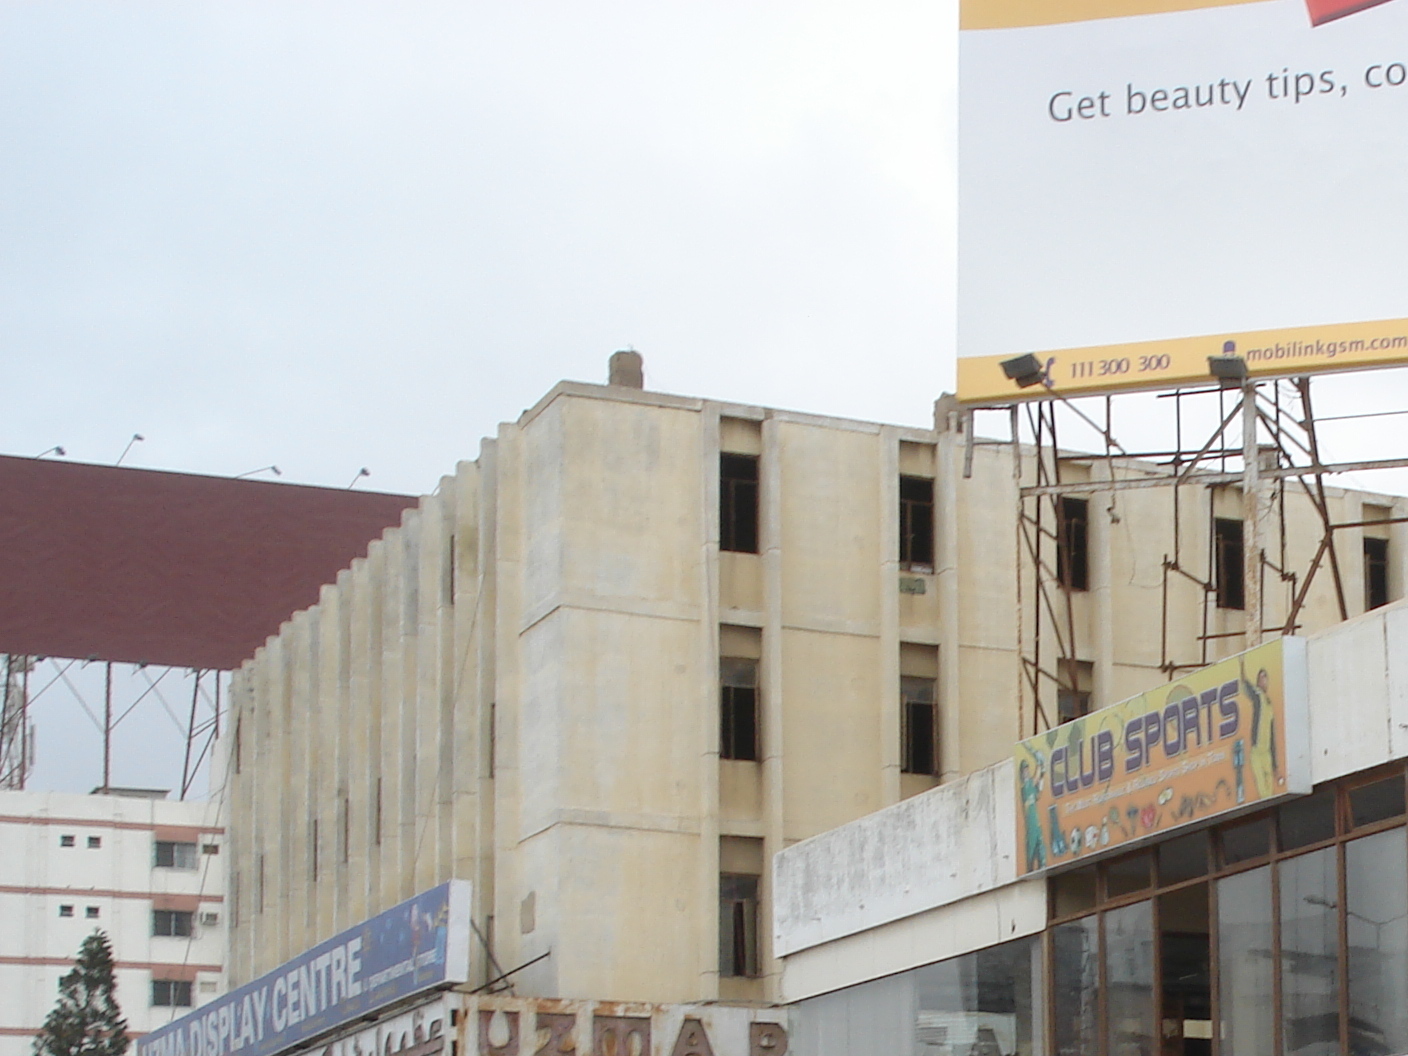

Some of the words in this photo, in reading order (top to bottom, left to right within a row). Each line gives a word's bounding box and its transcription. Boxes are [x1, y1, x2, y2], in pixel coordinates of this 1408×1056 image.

[1048, 92, 1111, 123] Get
[1126, 74, 1252, 117] beauty
[1265, 67, 1348, 104] tips,
[1098, 357, 1131, 376] 300
[1137, 353, 1171, 373] 300
[1050, 729, 1114, 799] CLUB
[1125, 679, 1240, 774] SPORTS
[271, 936, 364, 1033] CENTRE
